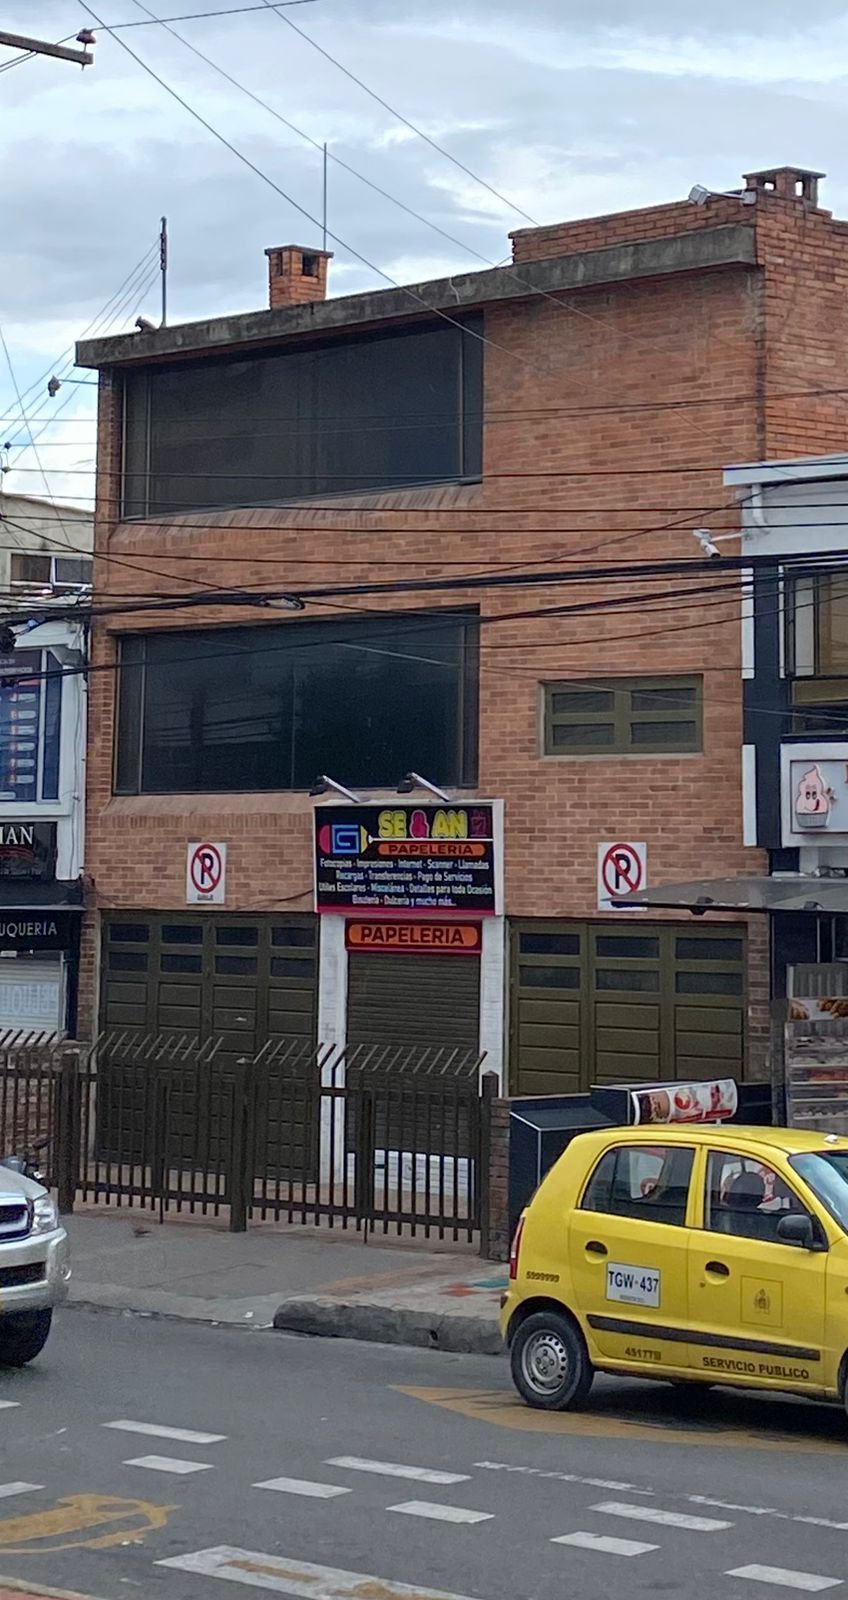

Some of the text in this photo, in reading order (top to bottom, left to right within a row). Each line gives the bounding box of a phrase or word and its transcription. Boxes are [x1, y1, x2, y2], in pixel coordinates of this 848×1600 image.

[378, 809, 468, 839] SE & AN
[388, 844, 473, 856] PAPELERIA
[320, 858, 489, 870] Fotocopias Impresiones Internet Scanner Llamadas
[336, 870, 473, 883] Recargas Transferencias Pago de Servicios
[337, 882, 366, 892] Escolares
[409, 883, 435, 893] Detalles
[436, 886, 450, 895] para
[451, 884, 466, 894] toda
[415, 896, 437, 906] mucho
[360, 926, 464, 945] PAPELERIA
[608, 1271, 659, 1293] TGW-437
[703, 1357, 809, 1380] SERVICIO PUBLICO
